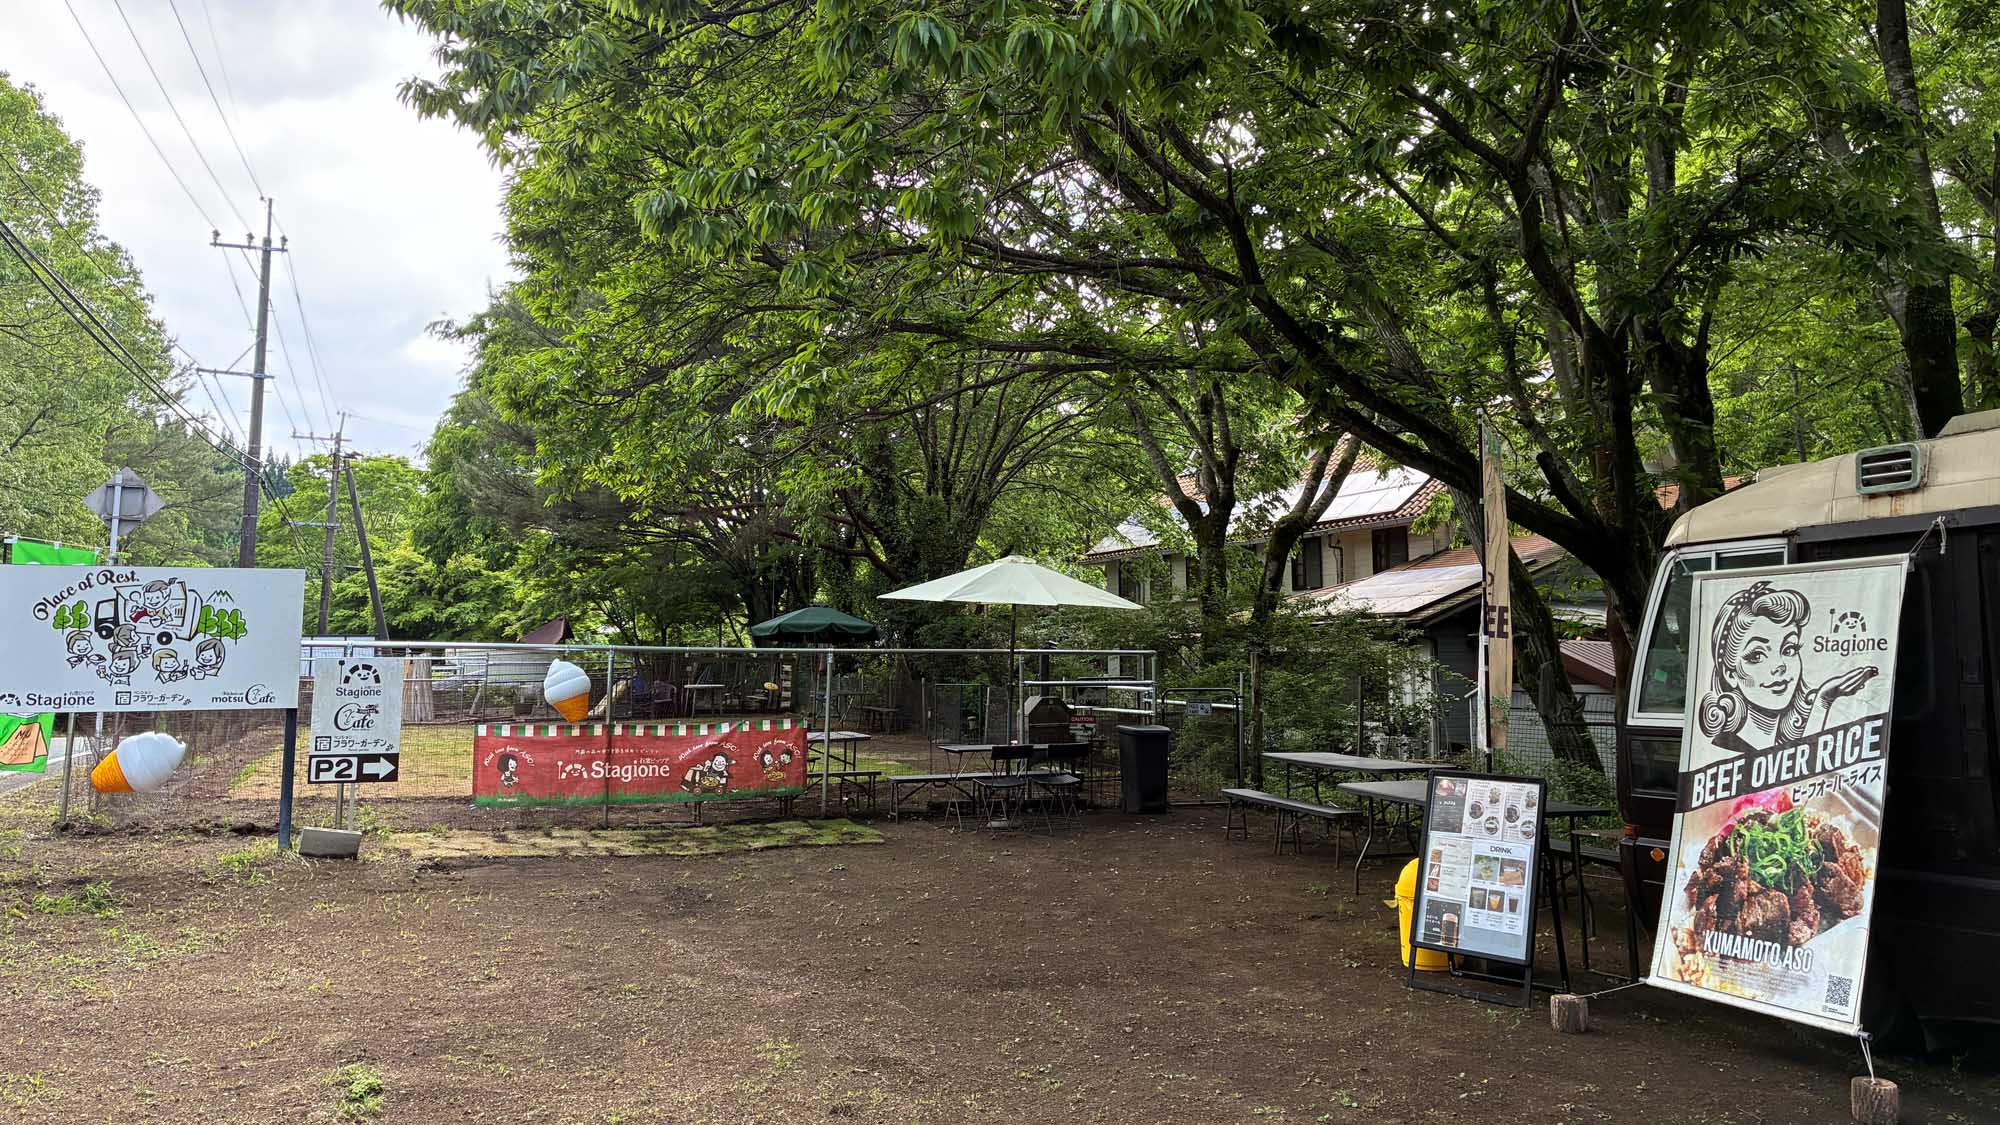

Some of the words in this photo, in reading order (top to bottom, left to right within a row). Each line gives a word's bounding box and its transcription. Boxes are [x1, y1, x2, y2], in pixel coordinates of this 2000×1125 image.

[33, 586, 77, 621] Place
[78, 572, 94, 591] of
[96, 569, 140, 585] Rest.
[1813, 633, 1888, 657] Stagione
[26, 692, 95, 709] Stagione
[211, 695, 244, 703] motsu
[335, 687, 382, 699] Stagione
[315, 758, 353, 780] P2
[591, 760, 670, 783] Stagione
[1691, 758, 1746, 809] BEEF
[1751, 743, 1809, 789] OVER
[1815, 718, 1883, 774] RICE
[1489, 845, 1513, 854] DRINK
